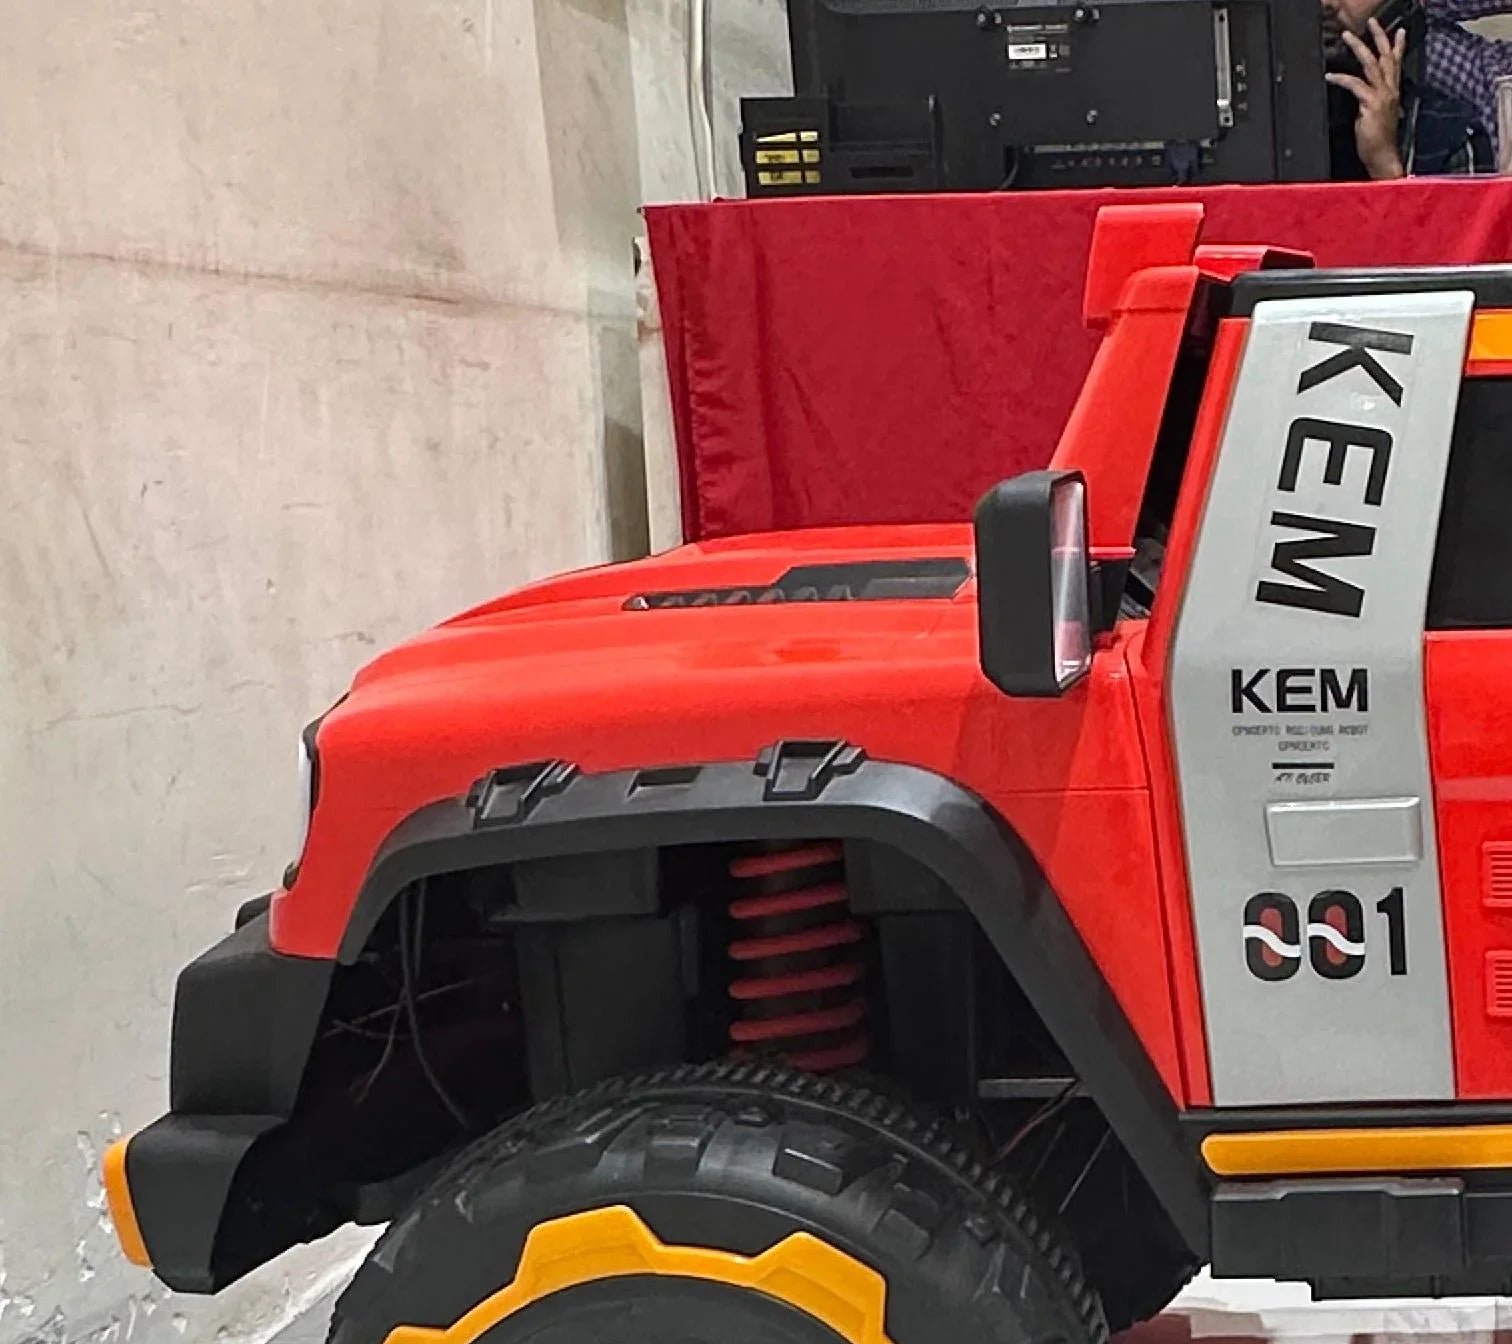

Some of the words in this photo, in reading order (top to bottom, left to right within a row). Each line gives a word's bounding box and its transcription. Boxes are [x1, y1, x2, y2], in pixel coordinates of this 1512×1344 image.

[1255, 321, 1415, 618] KEM
[1231, 668, 1369, 714] KEM
[1243, 886, 1408, 982] 001
